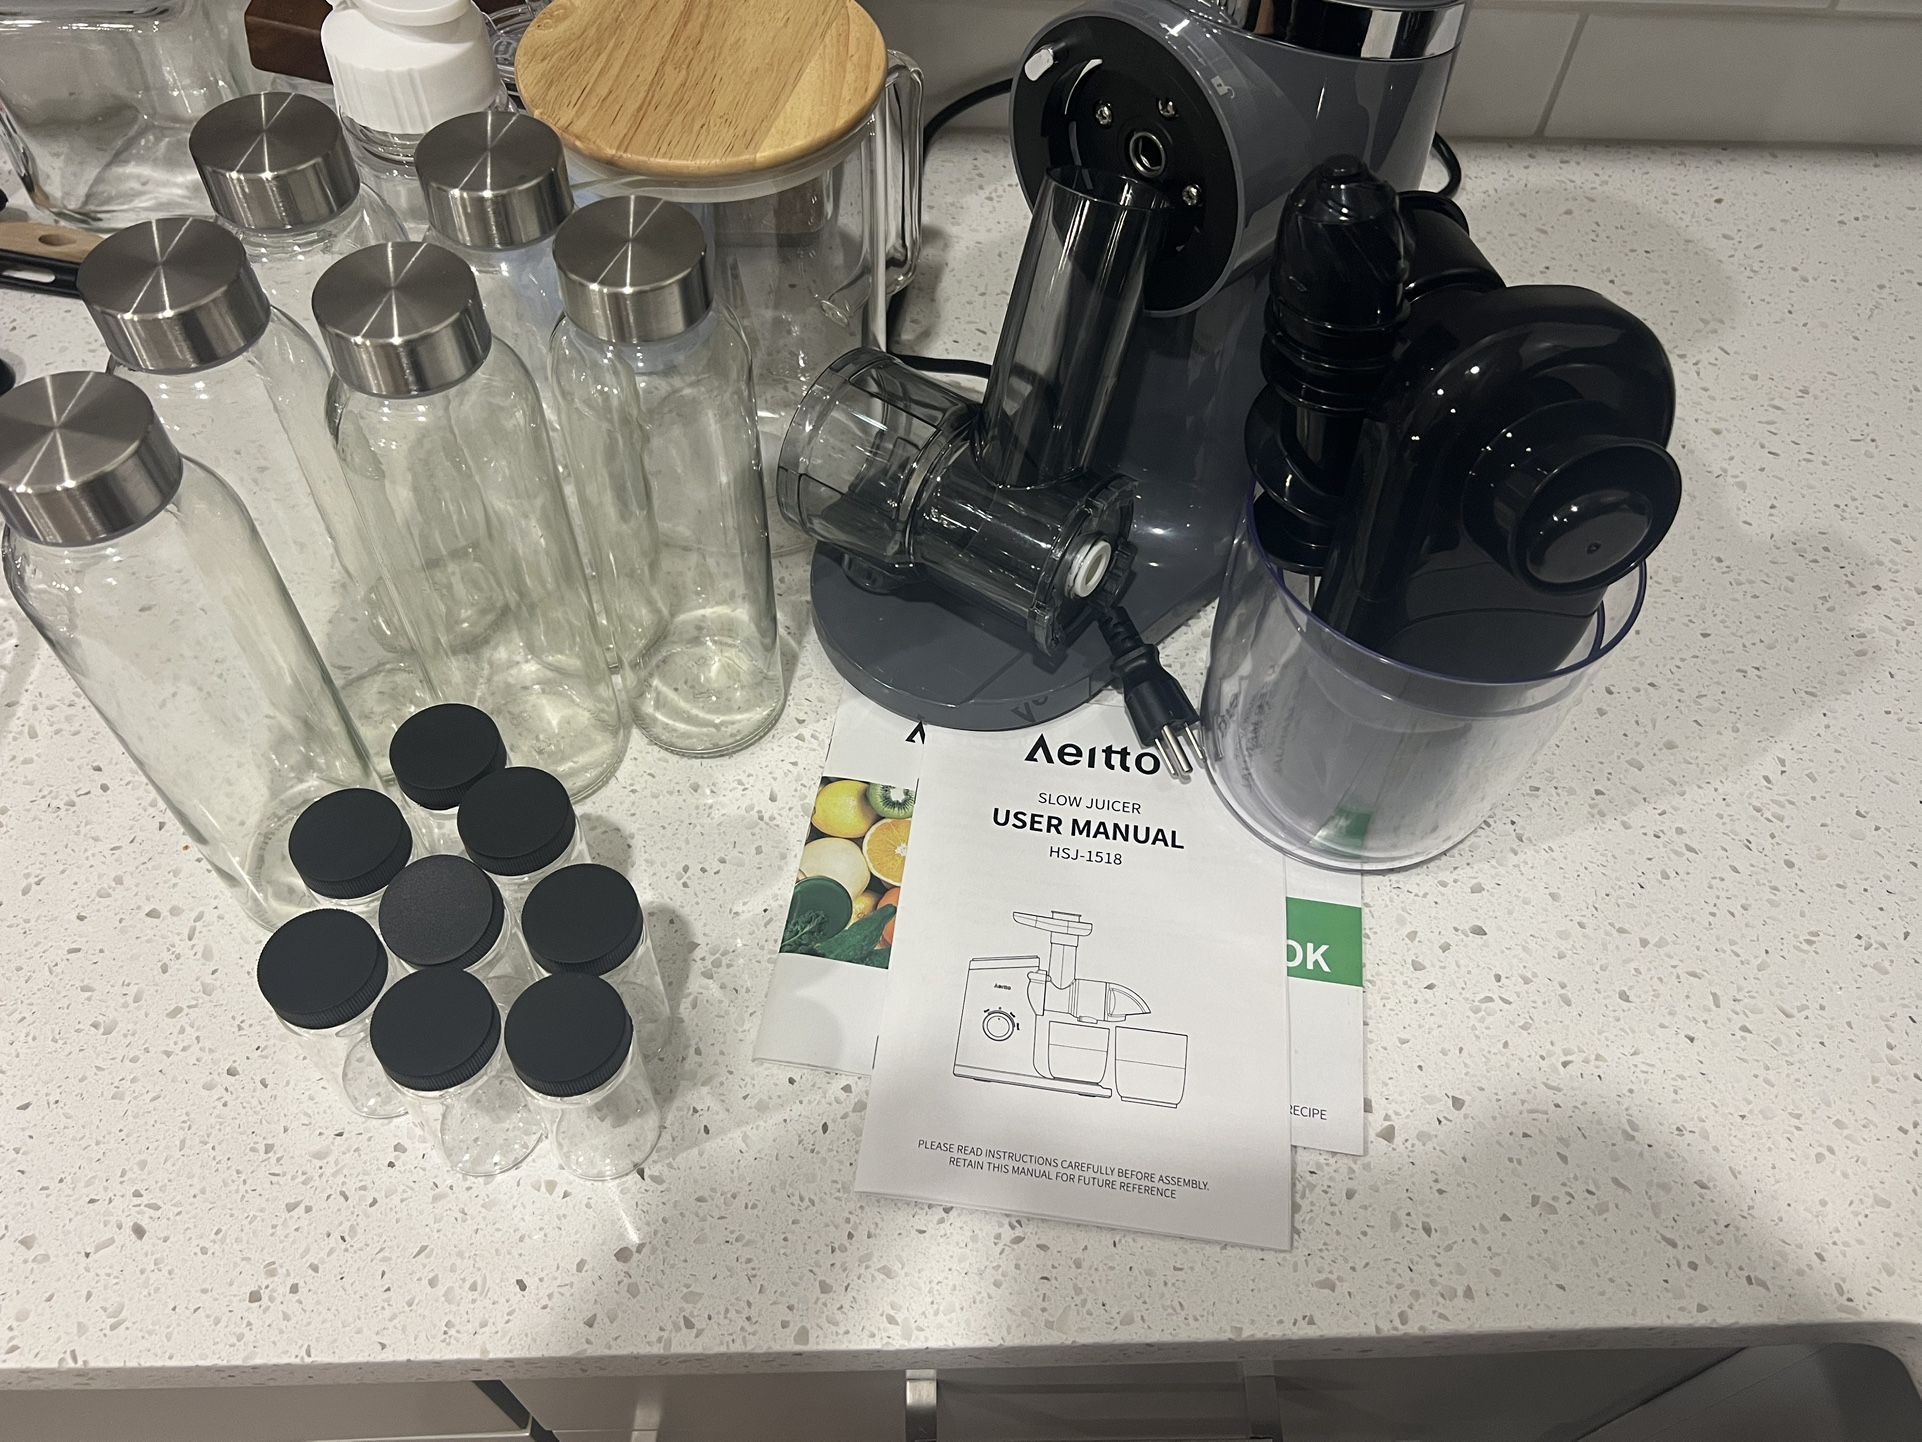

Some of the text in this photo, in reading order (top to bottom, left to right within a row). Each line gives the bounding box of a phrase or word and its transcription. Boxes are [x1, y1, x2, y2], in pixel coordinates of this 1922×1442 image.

[1024, 733, 1161, 775] Aeitto
[1038, 792, 1141, 815] SLOW JUICER
[992, 807, 1185, 850] USER MANUAL
[1049, 846, 1123, 866] HSJ-1518
[918, 1139, 1210, 1191] PLEASE READ INSTRUCTIONS CAREFULLY BEFORE ASSEMBLY.
[949, 1156, 1177, 1199] RETAIN THIS MANUAL FOR FUTURE REFERENCE
